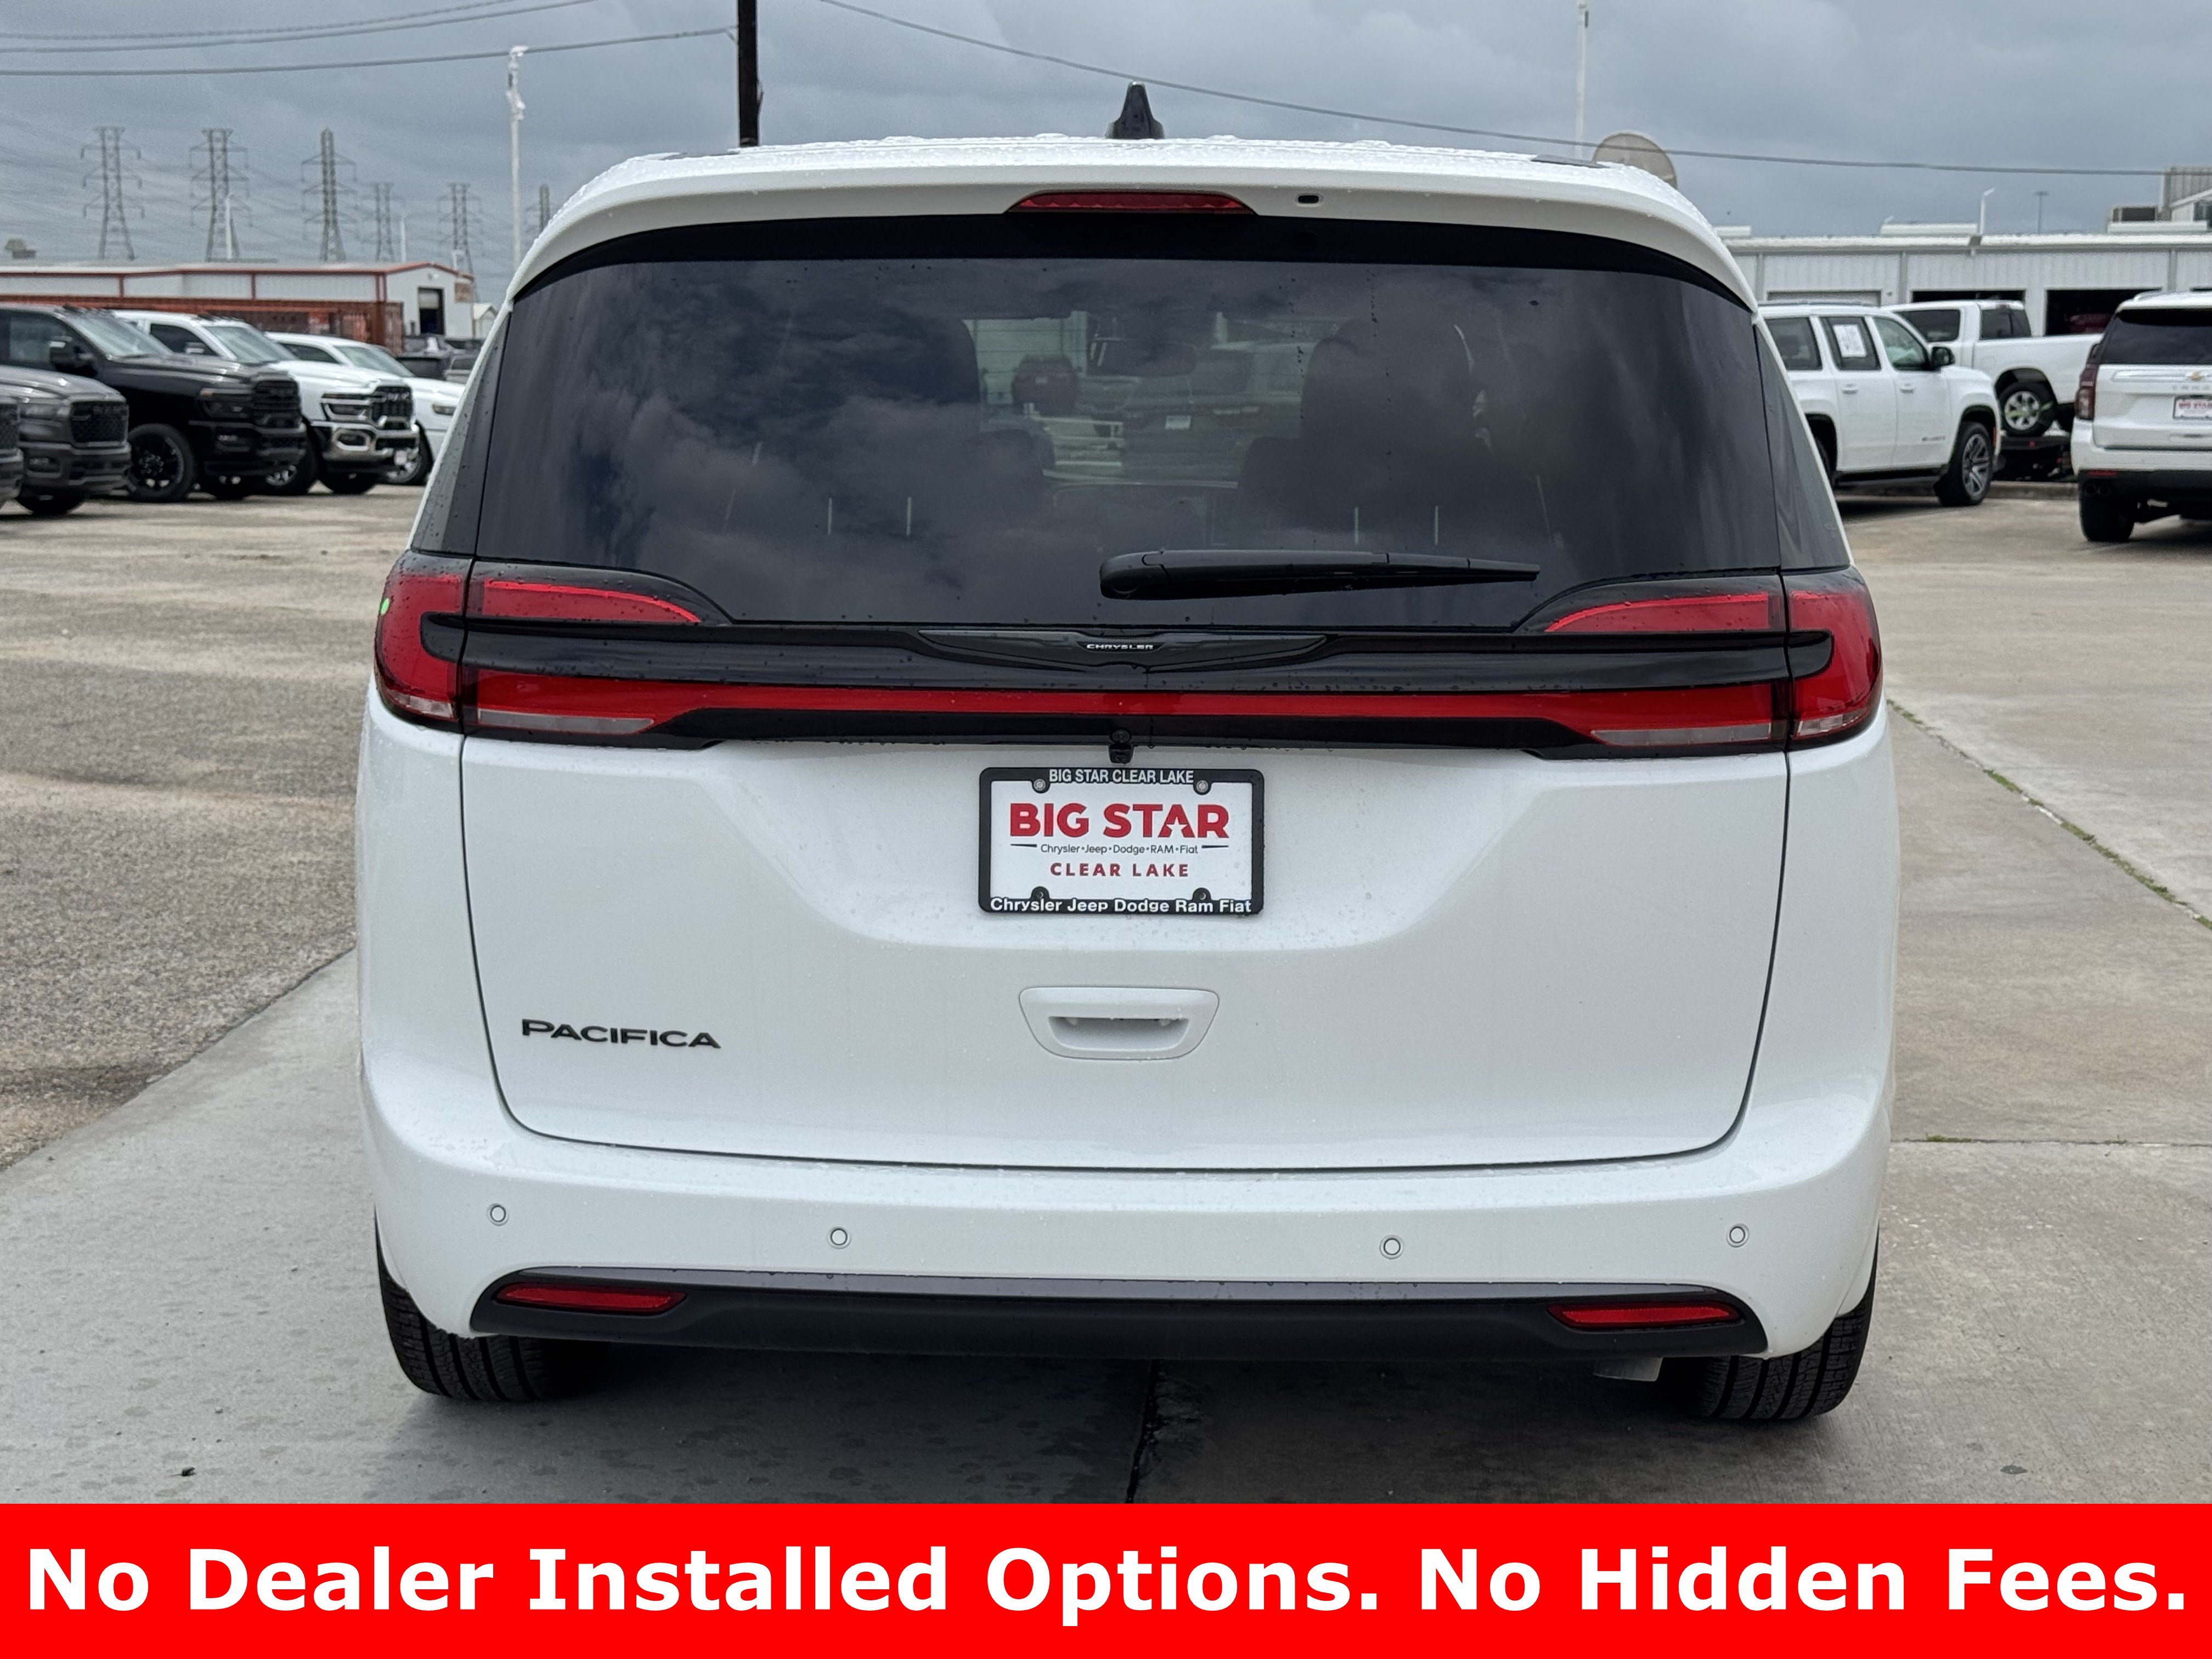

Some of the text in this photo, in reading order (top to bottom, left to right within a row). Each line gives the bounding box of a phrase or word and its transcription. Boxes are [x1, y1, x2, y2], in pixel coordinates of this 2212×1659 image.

[1049, 769, 1194, 783] BIG STAR CLEAR LAKE
[1010, 803, 1229, 838] BIG STAR
[1050, 863, 1188, 877] CLEAR LAKE
[990, 898, 1251, 912] Chrysler Jeep Dodge Ram Fiat
[522, 1019, 721, 1049] PACIFICA
